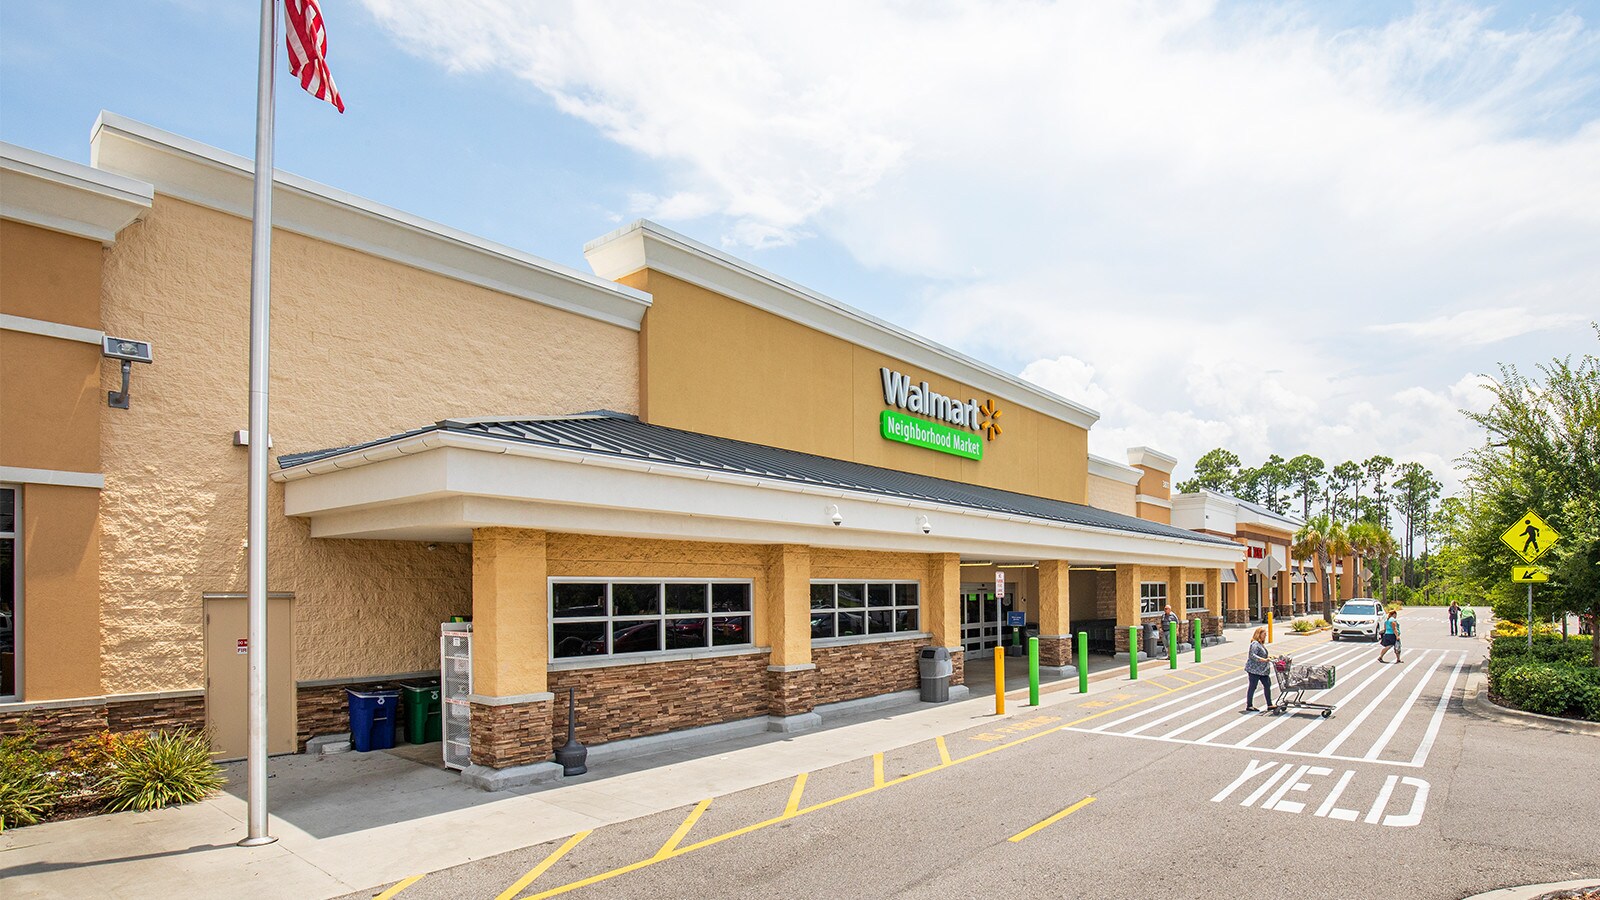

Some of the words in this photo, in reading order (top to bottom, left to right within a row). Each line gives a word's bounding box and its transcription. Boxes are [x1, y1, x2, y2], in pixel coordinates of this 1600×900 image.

[880, 367, 980, 431] Walmart
[887, 416, 951, 448] Neighborhood
[953, 434, 980, 455] Market
[1210, 759, 1431, 827] YIELD
